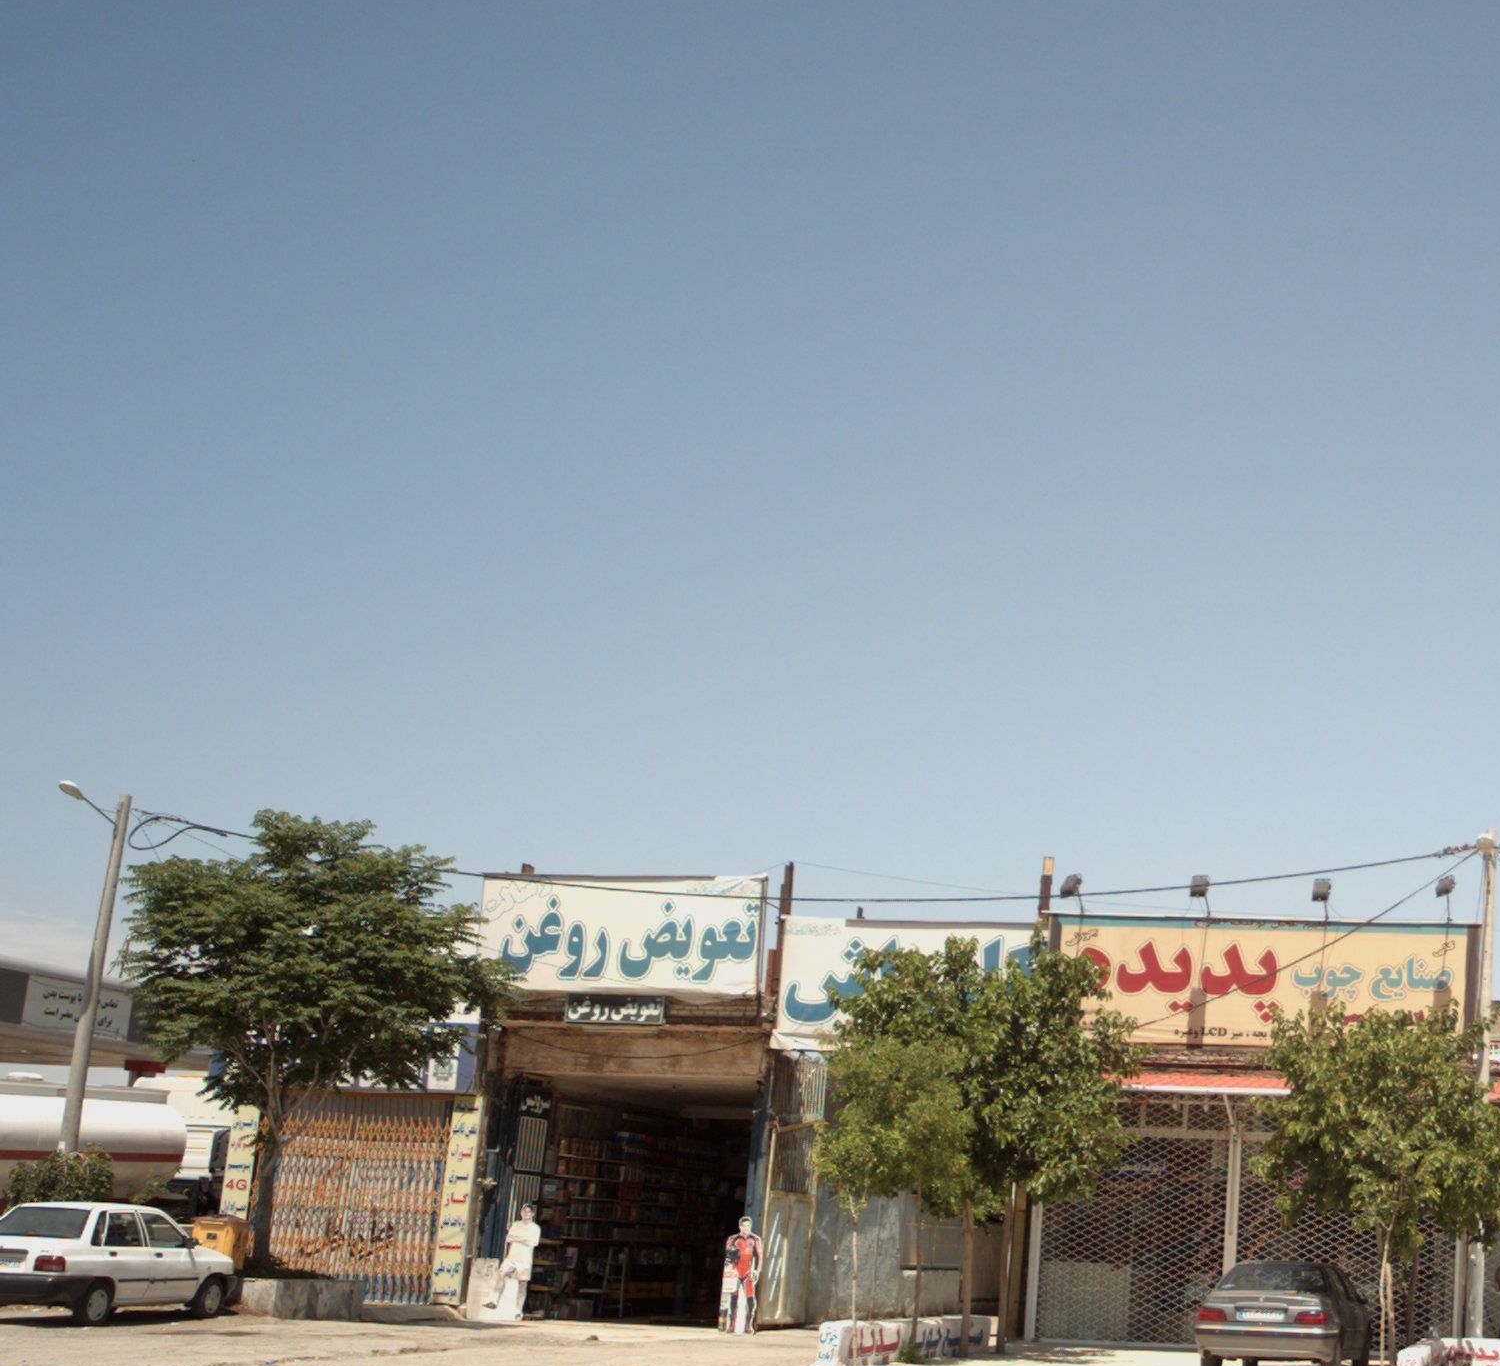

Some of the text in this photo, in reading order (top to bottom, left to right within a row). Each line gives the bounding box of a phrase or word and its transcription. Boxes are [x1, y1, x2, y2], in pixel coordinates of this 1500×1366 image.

[502, 897, 609, 978] روغن
[620, 901, 759, 983] تعویض
[1081, 939, 1279, 1024] پدیده
[1293, 963, 1362, 1000] چوب
[1371, 956, 1452, 1000] صنایع
[568, 997, 663, 1021] تعویض روغن
[1201, 1026, 1227, 1037] LCD
[226, 1179, 247, 1190] 4G
